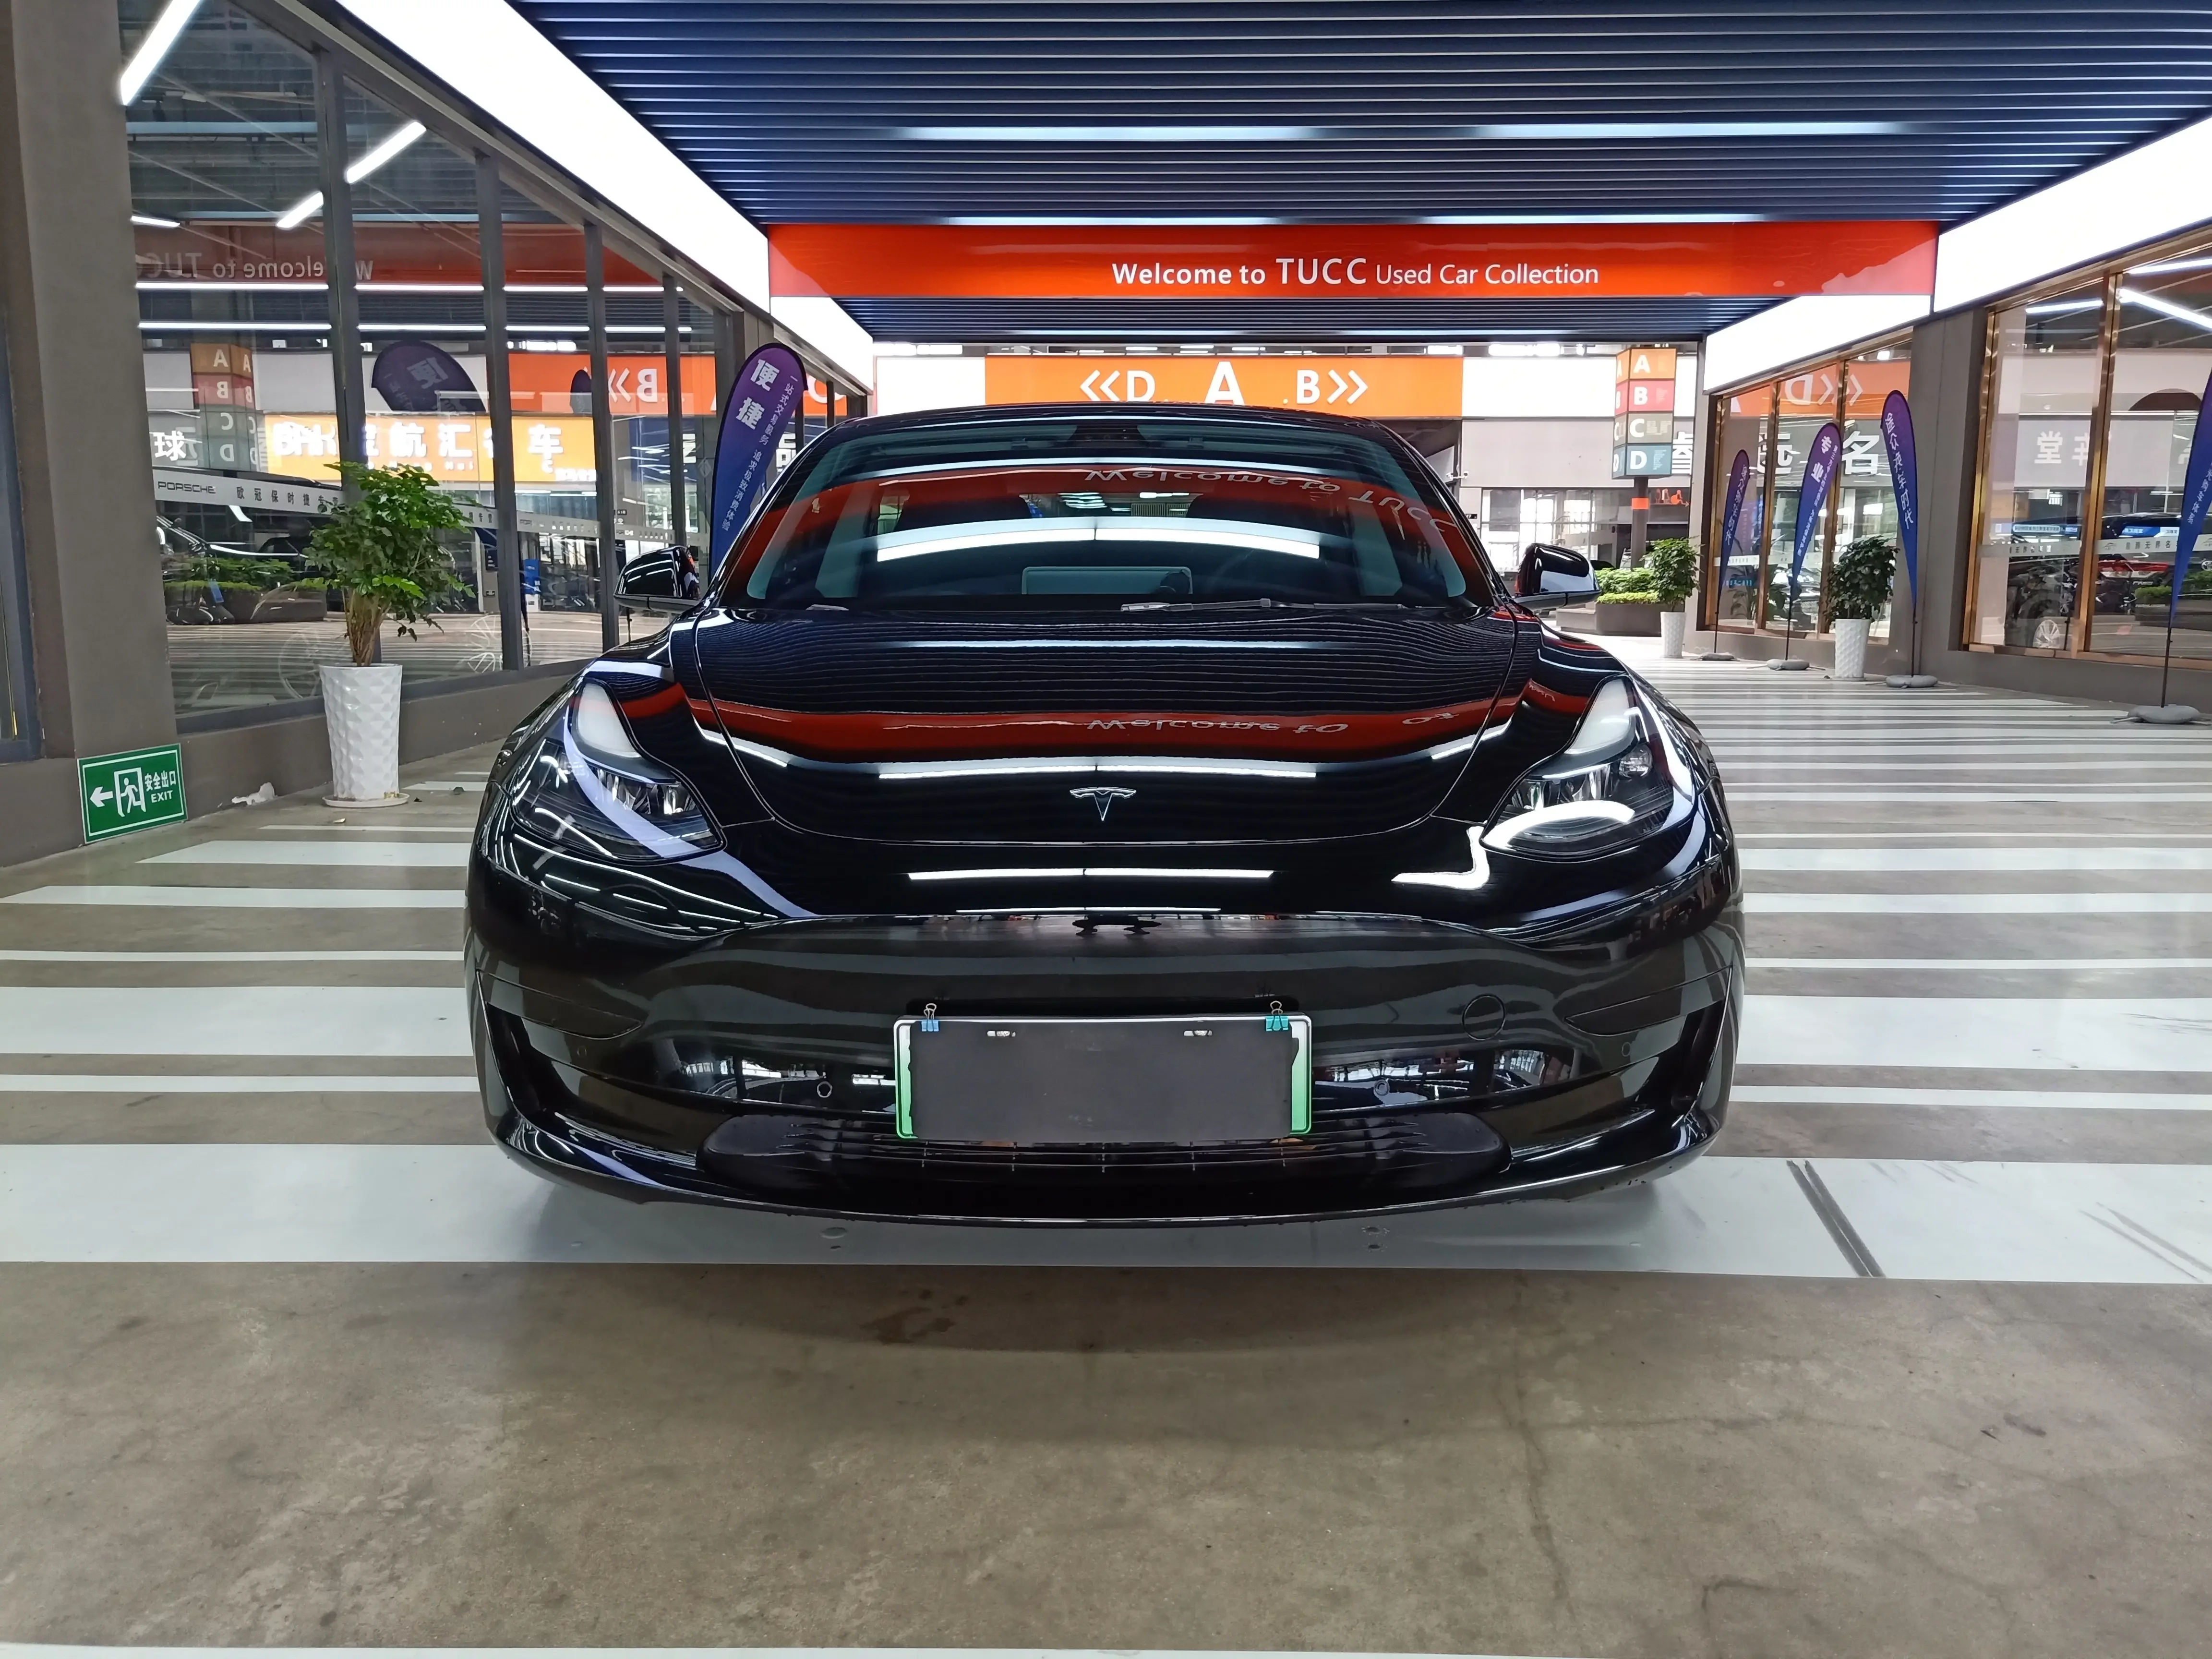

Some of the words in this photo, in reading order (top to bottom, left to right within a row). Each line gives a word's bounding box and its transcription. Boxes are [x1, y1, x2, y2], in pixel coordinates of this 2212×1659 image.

[1112, 262, 1232, 285] Welcome
[1239, 266, 1266, 285] to
[1275, 257, 1367, 285] TUCC
[1376, 264, 1431, 285] Used
[1440, 264, 1478, 284] Car
[1485, 263, 1599, 285] Collection
[1633, 354, 1651, 373] A
[1127, 370, 1155, 401] D
[1204, 361, 1245, 405] A
[1297, 370, 1321, 404] B
[736, 359, 780, 430] 便捷
[1634, 386, 1648, 405] B
[759, 375, 798, 446] 一站式交易服务
[1629, 418, 1645, 438] C
[153, 430, 187, 461] 球
[1630, 450, 1647, 469] D
[158, 481, 216, 494] PORSCHE
[144, 770, 177, 792] 安全出口
[151, 790, 173, 804] EXIT
